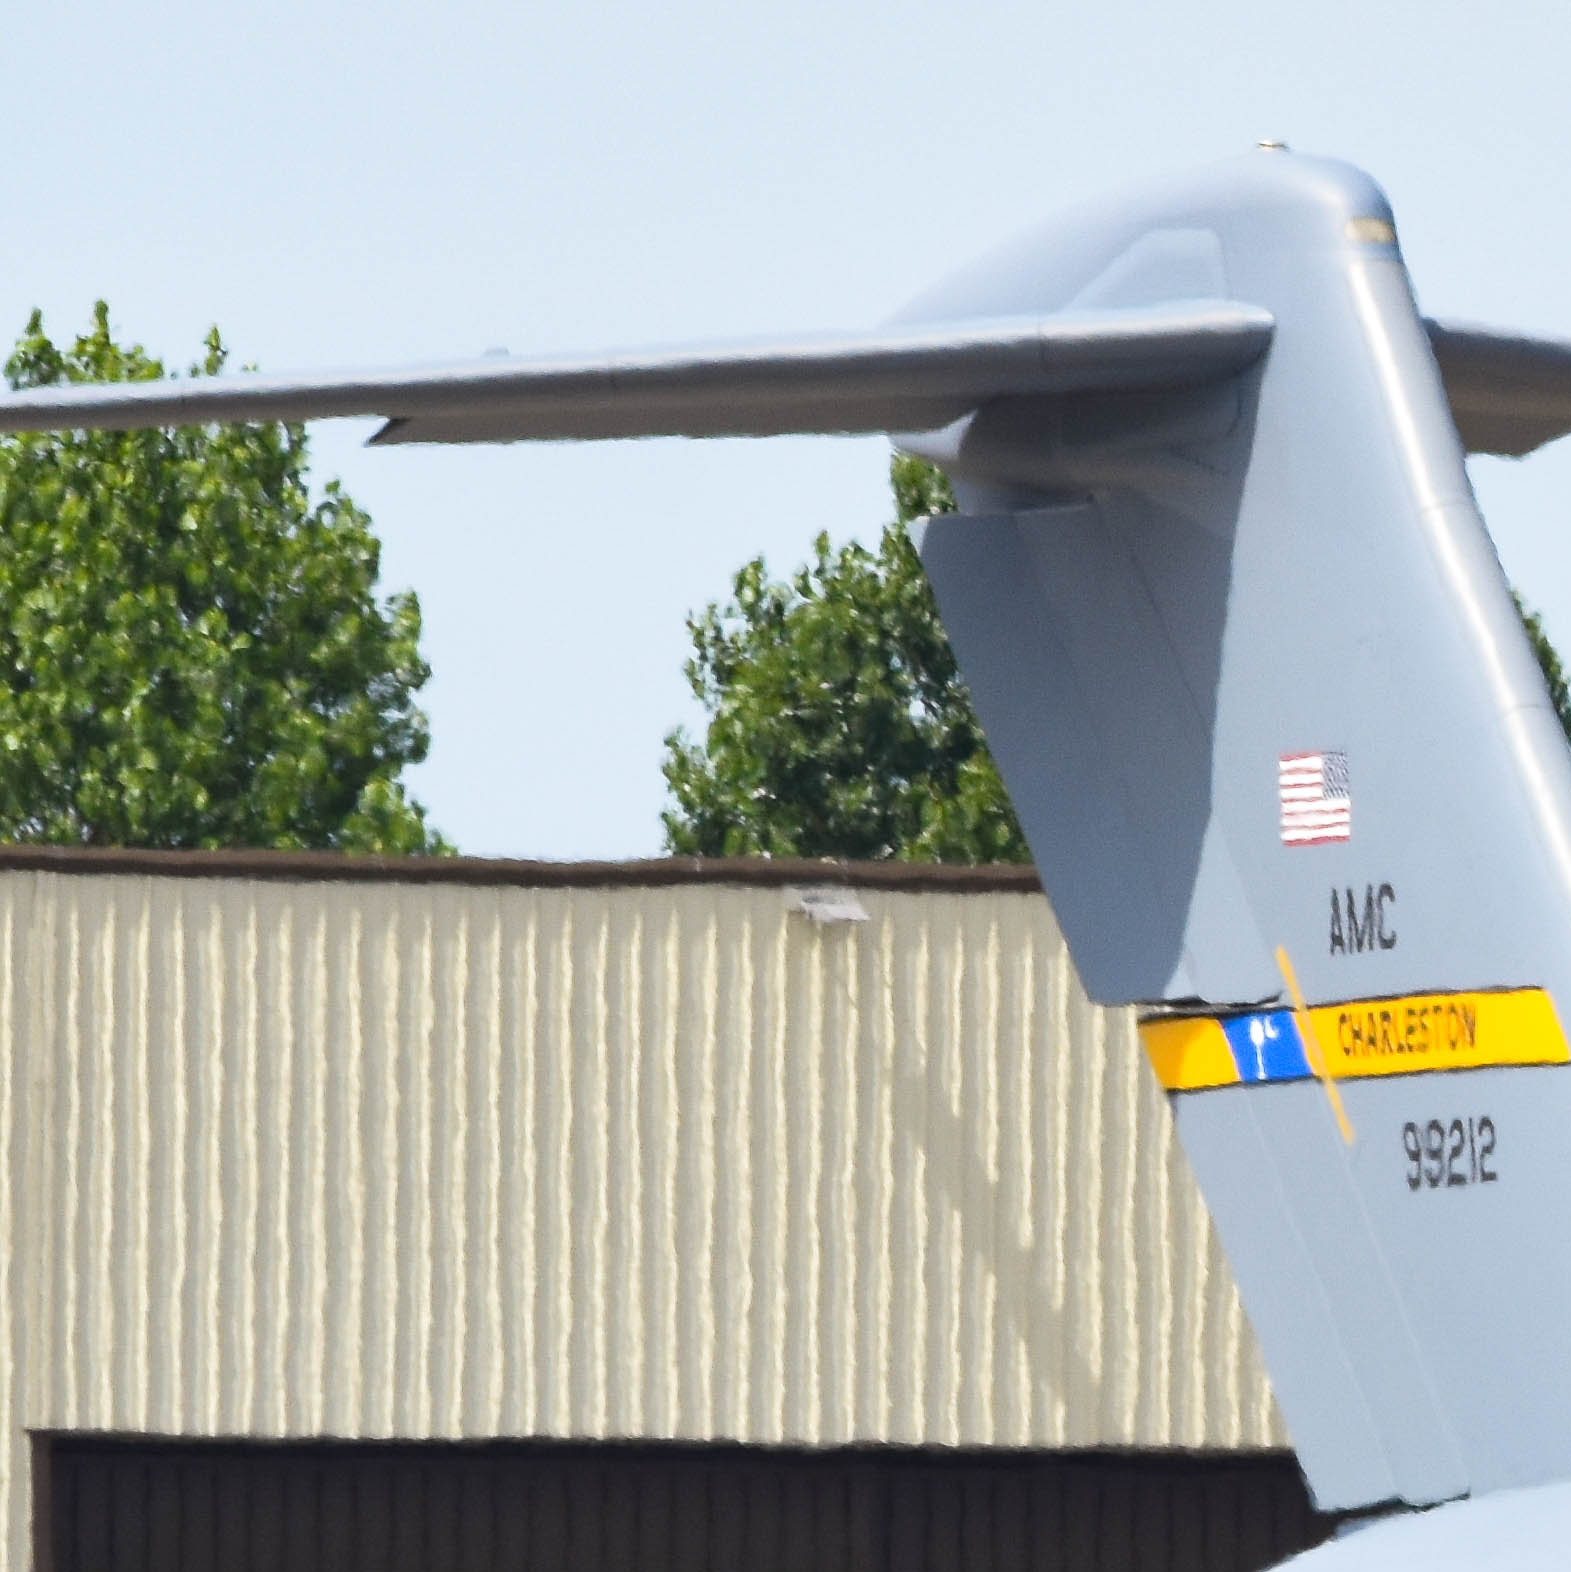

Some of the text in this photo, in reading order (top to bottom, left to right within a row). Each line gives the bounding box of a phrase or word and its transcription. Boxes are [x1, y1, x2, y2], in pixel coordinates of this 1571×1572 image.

[1328, 882, 1398, 956] AMC
[1336, 1002, 1477, 1056] CHARLESTON
[1403, 1116, 1498, 1190] 99212
